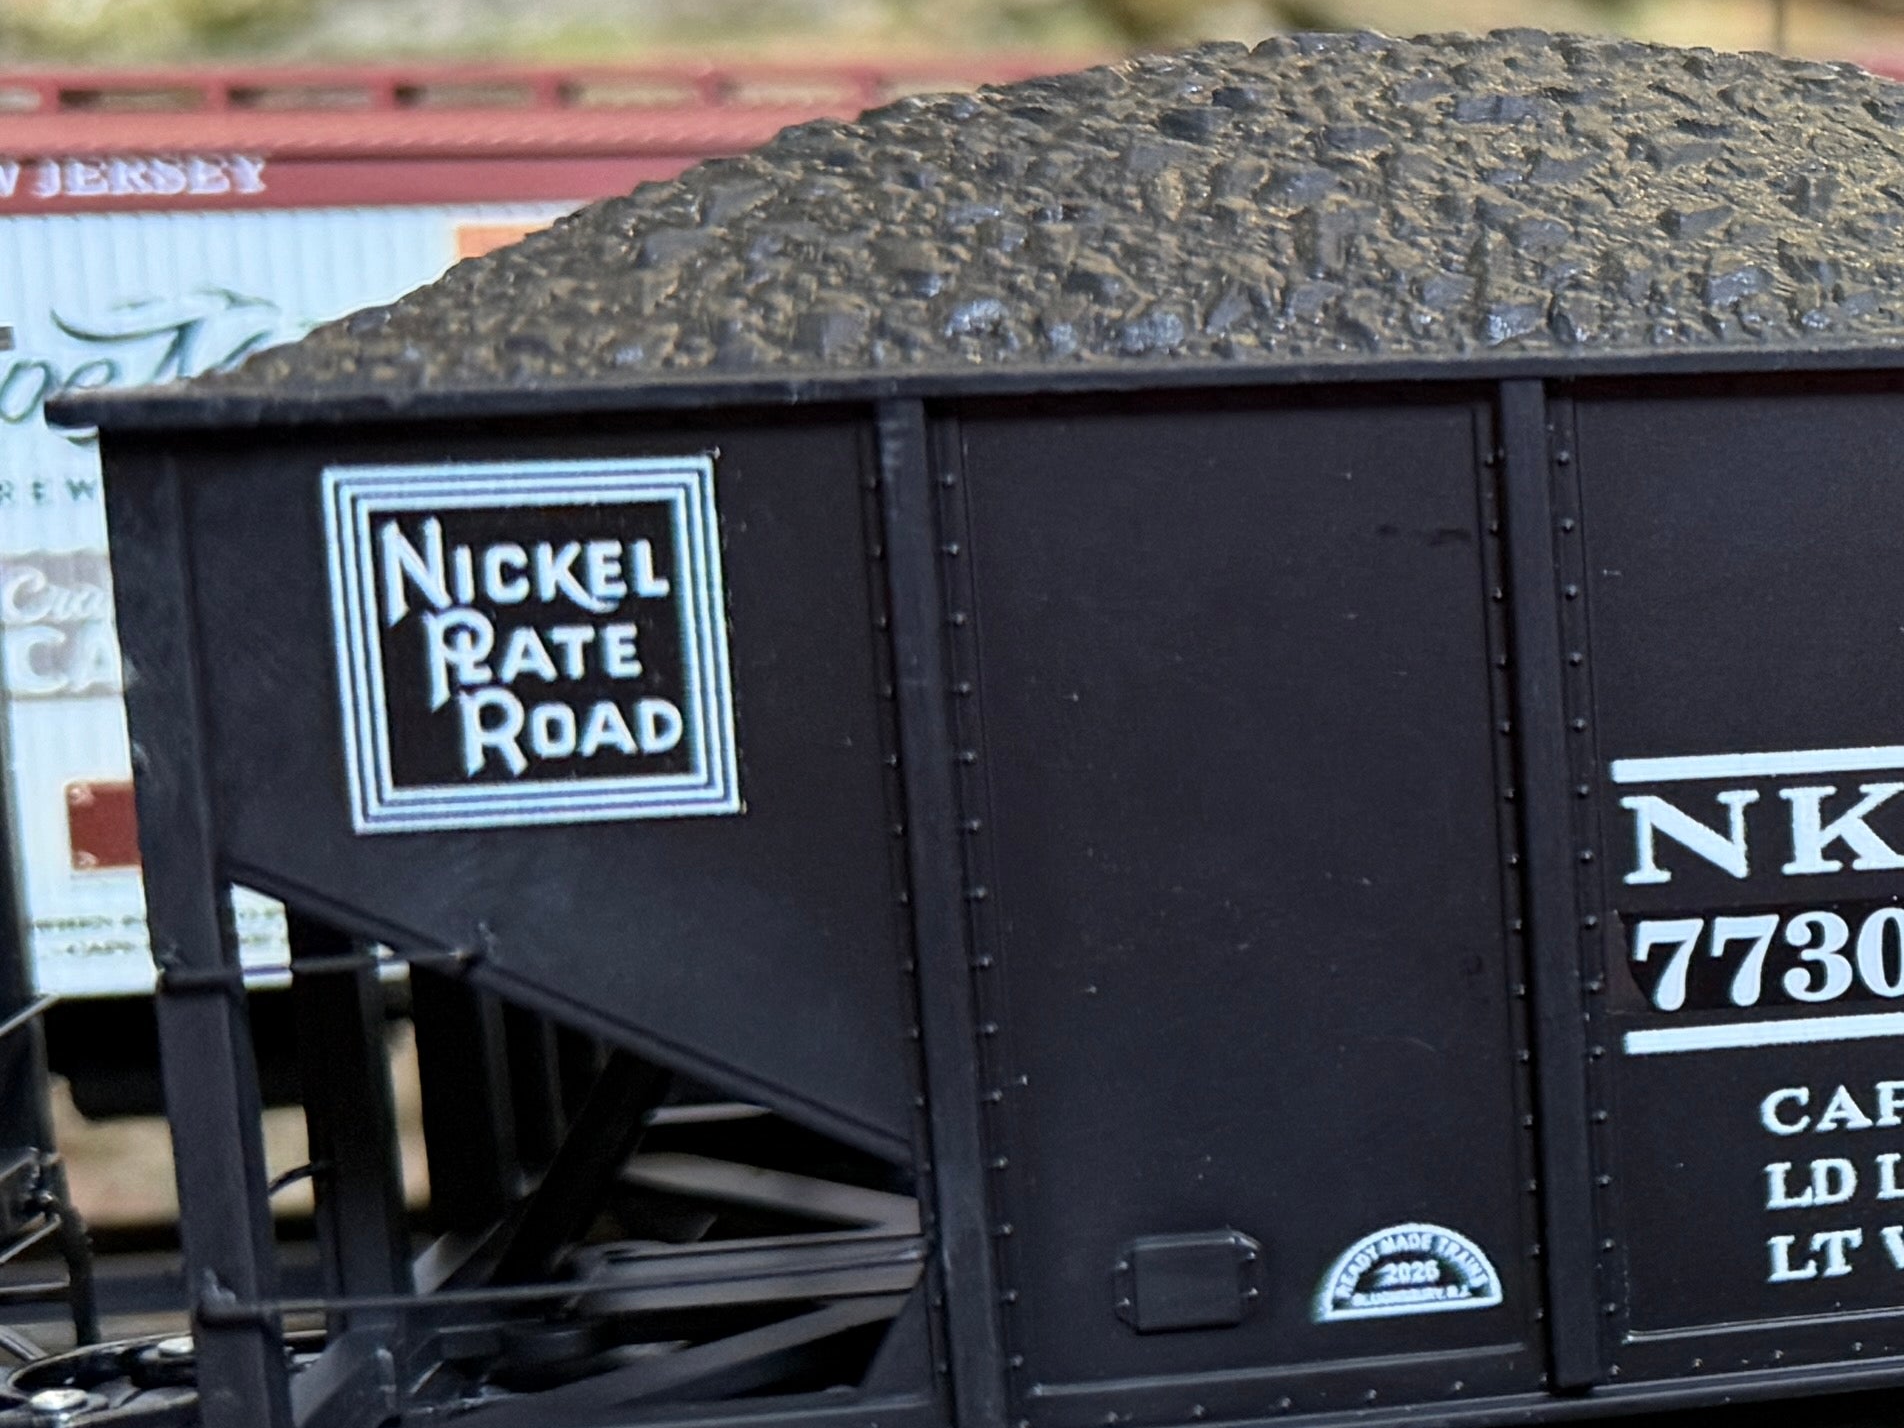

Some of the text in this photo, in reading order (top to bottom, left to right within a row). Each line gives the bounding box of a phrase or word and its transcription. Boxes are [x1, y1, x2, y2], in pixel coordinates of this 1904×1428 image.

[30, 155, 266, 198] JERSEY
[382, 518, 669, 622] NICKEL
[427, 608, 643, 708] PLATE
[458, 692, 683, 778] ROAD
[1764, 1158, 1858, 1209] LD
[1380, 1232, 1432, 1256] MADE
[1767, 1227, 1863, 1282] LT
